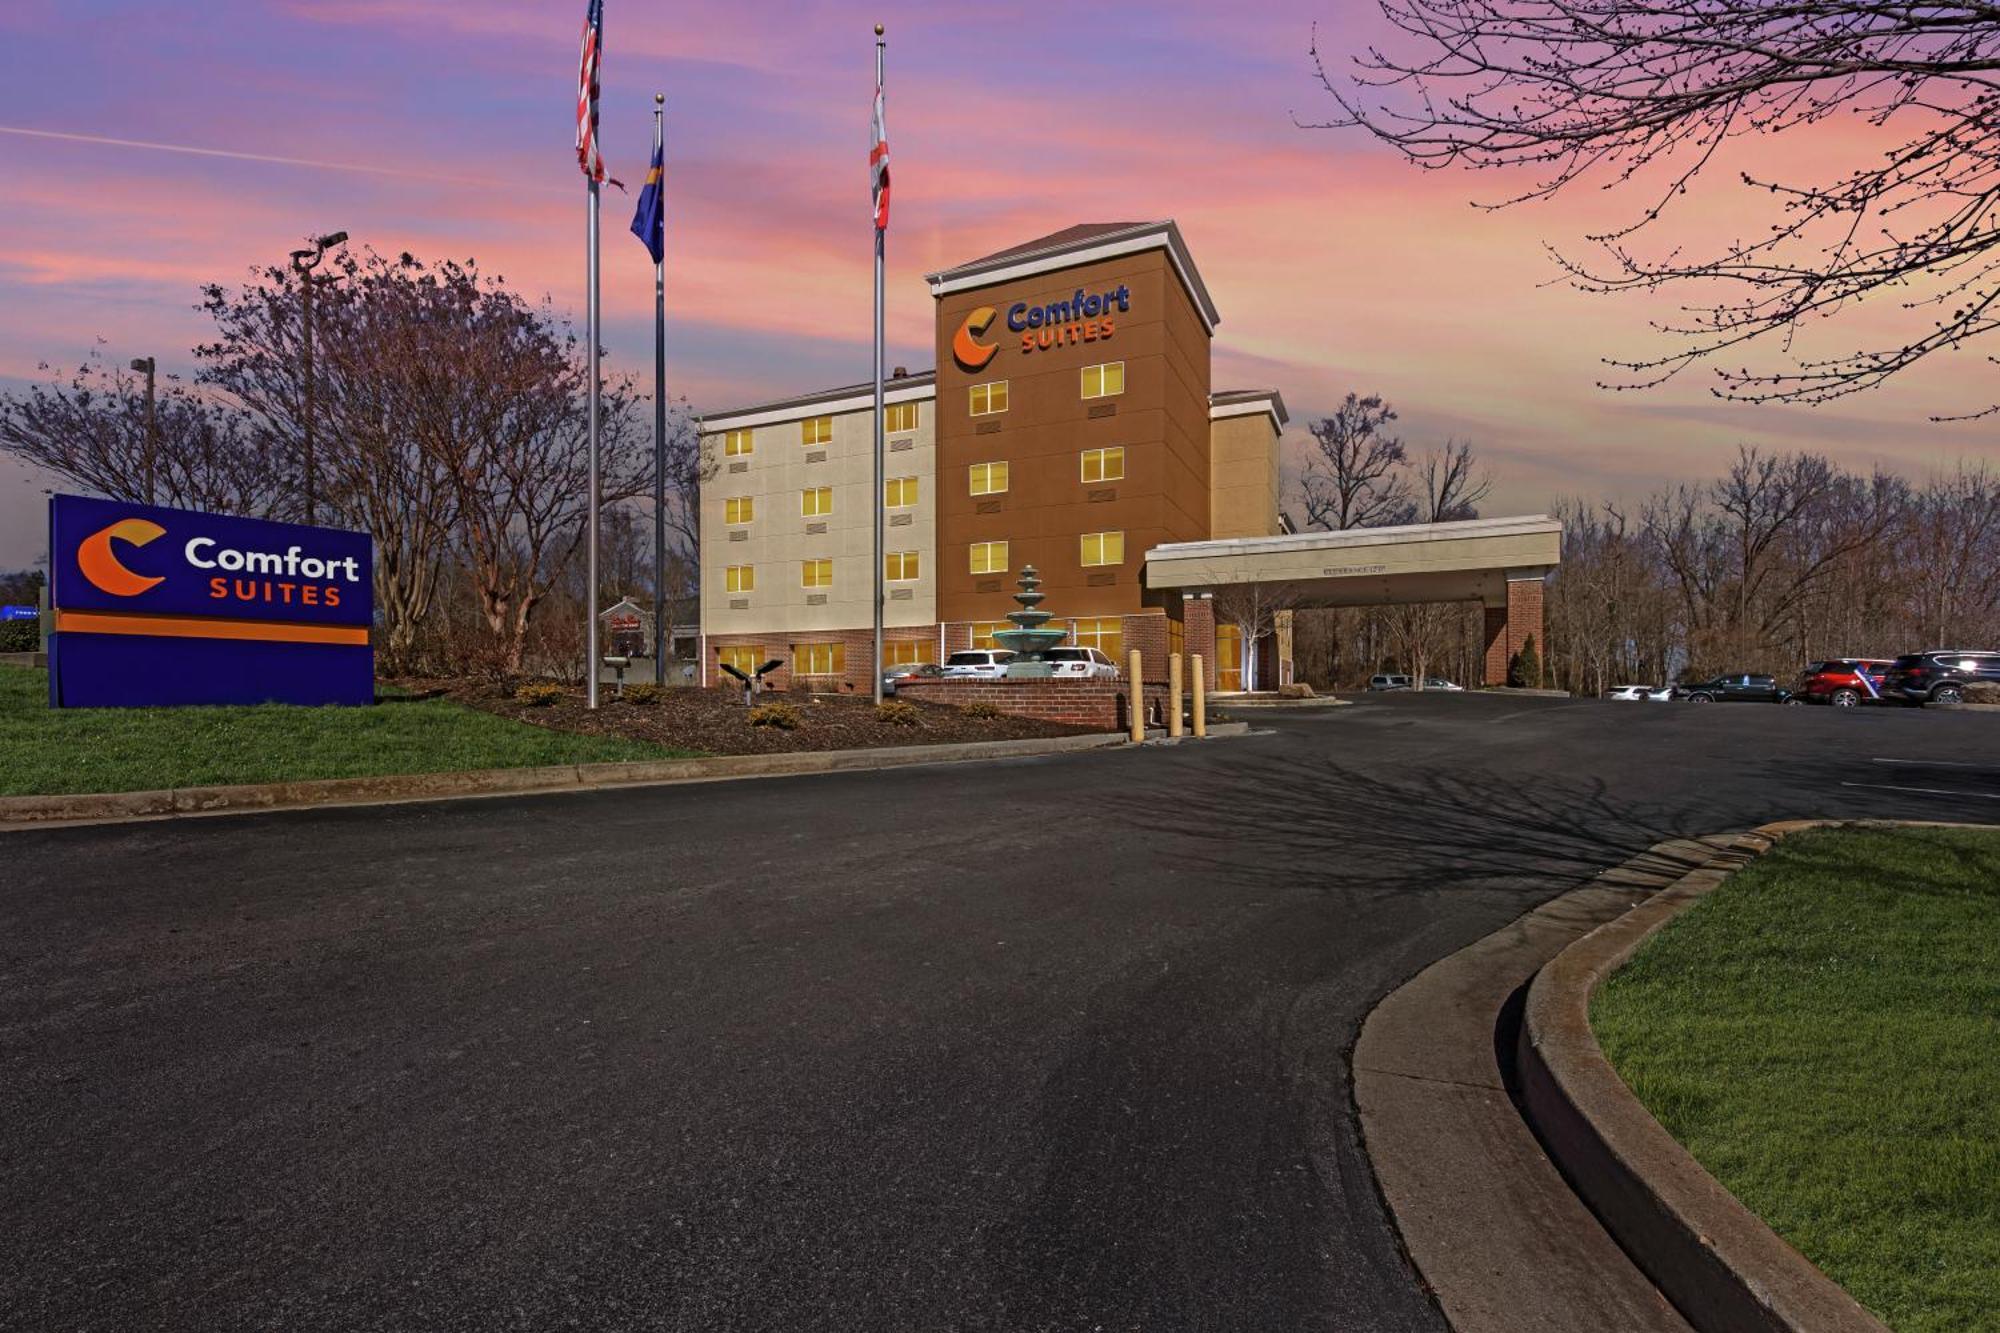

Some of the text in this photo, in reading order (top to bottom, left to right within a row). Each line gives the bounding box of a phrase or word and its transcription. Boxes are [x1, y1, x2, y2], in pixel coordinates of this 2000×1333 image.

[1008, 284, 1129, 332] Comfort
[1022, 316, 1115, 353] SUITES
[184, 537, 359, 582] Comfort
[210, 577, 341, 606] SUITES
